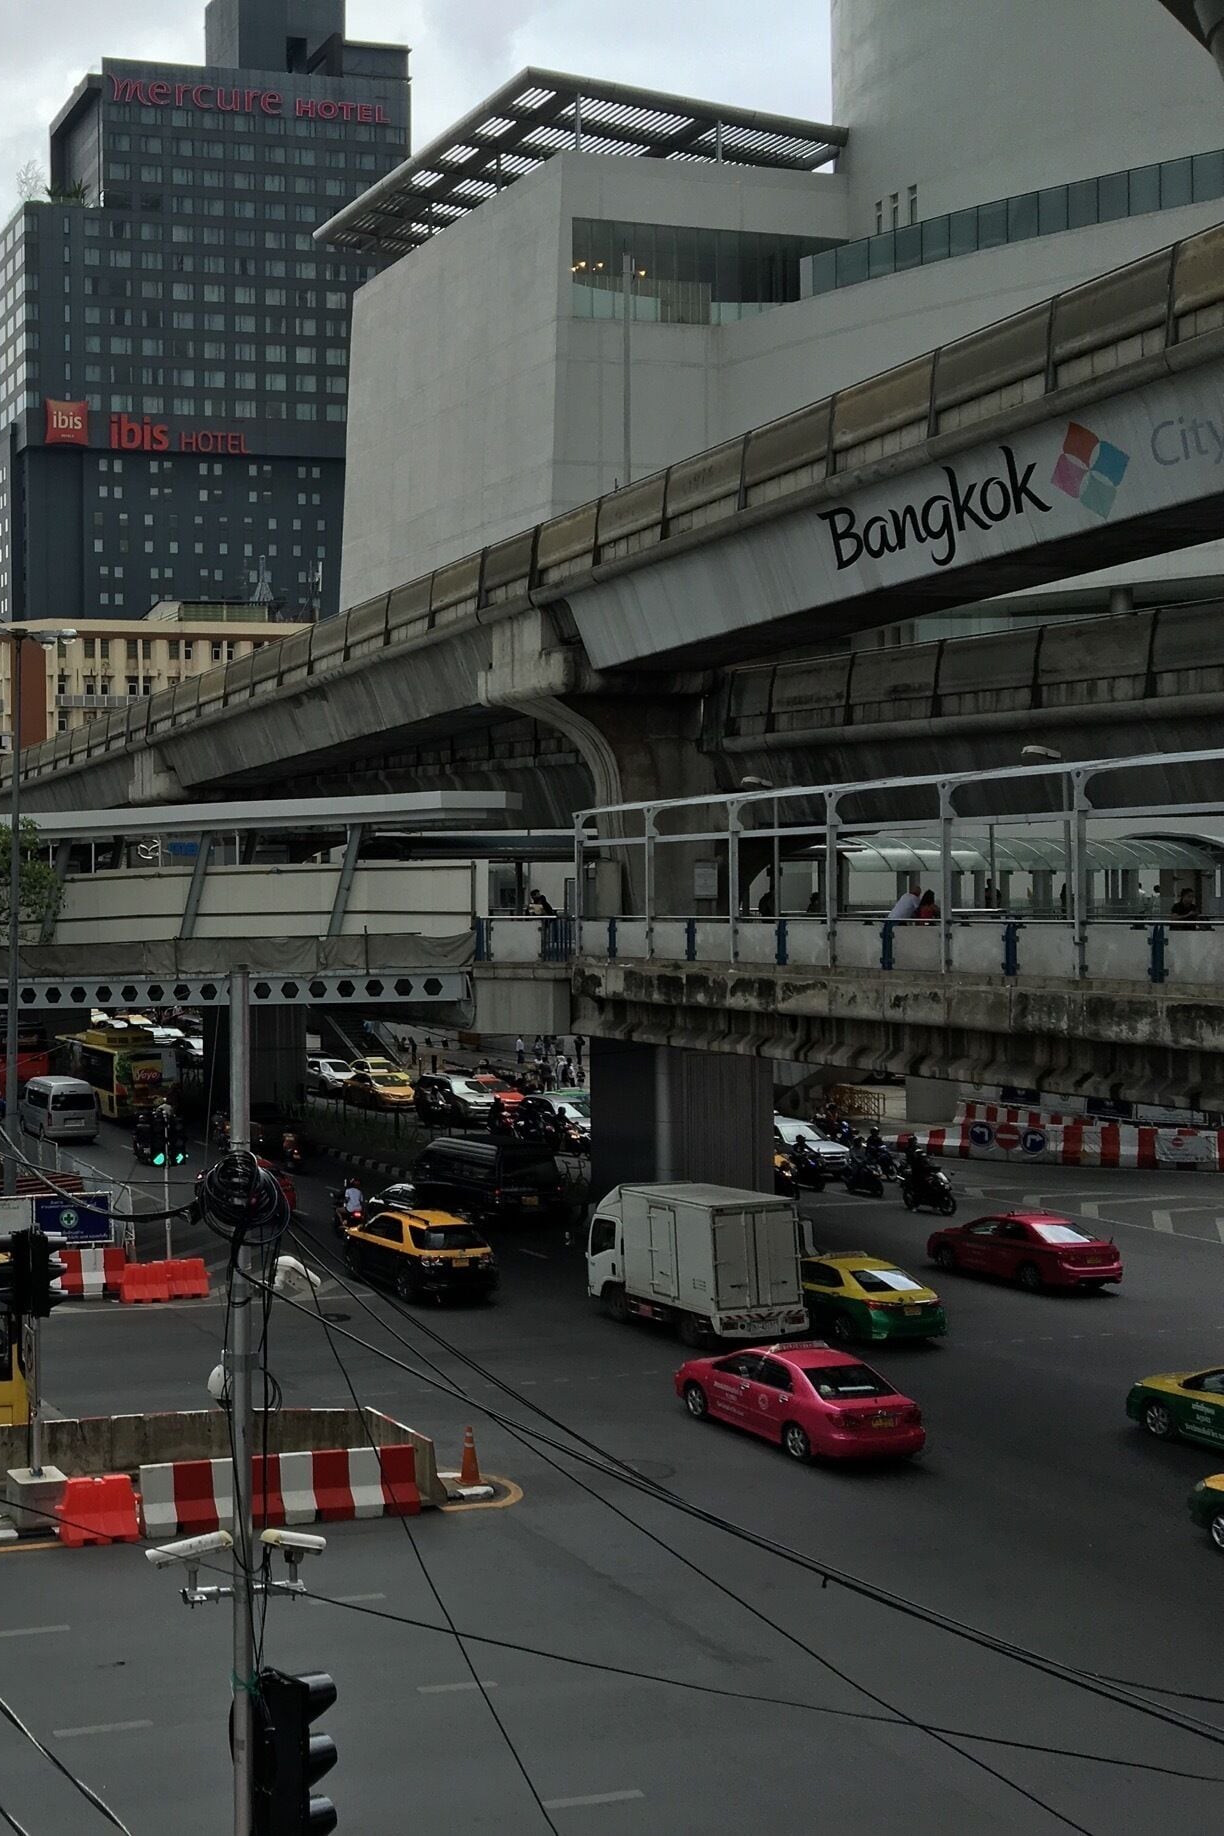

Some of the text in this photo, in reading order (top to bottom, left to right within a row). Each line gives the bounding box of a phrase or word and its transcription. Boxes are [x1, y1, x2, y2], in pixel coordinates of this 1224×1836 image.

[295, 98, 391, 124] HOTEL
[52, 410, 83, 431] ibis
[109, 414, 252, 455] ibis HOTEL
[817, 445, 1053, 571] Bangkok
